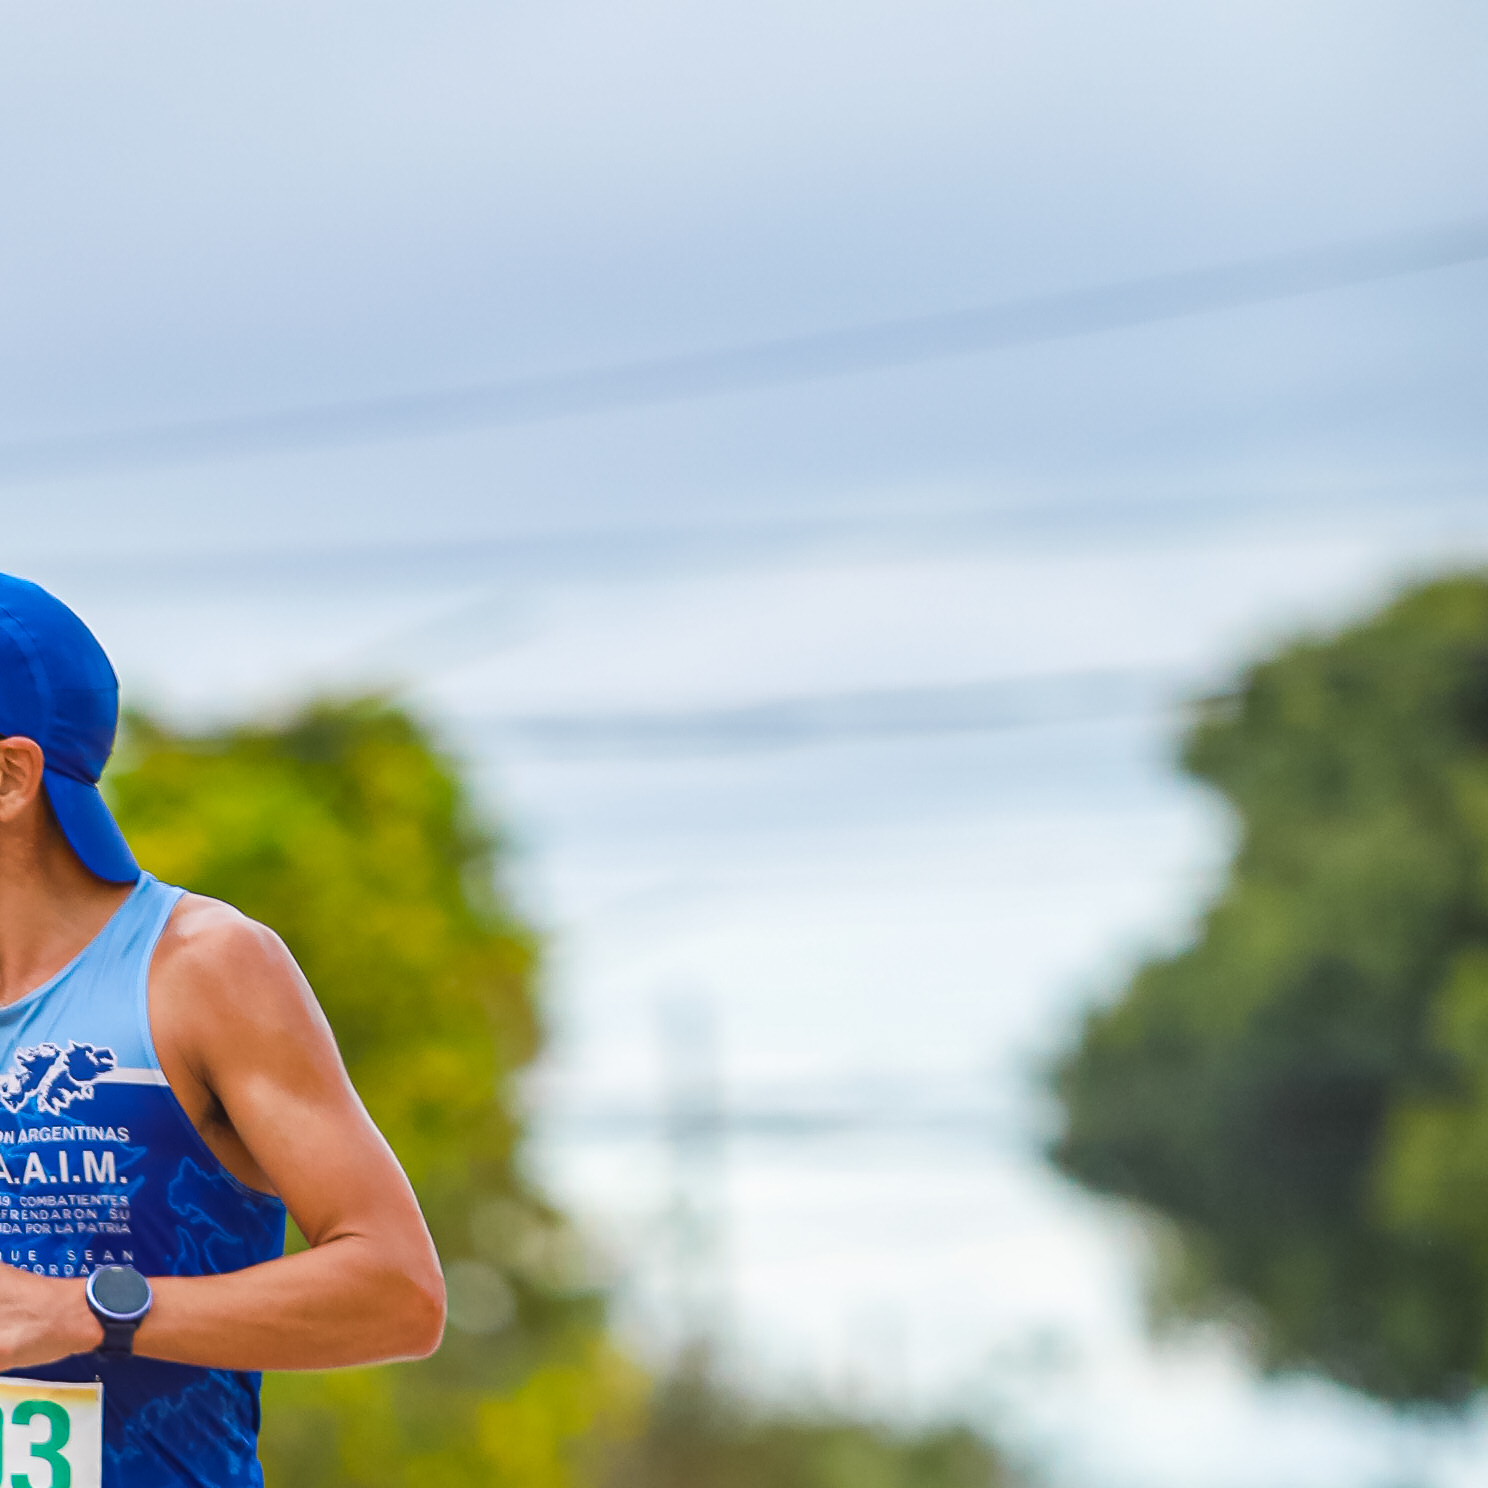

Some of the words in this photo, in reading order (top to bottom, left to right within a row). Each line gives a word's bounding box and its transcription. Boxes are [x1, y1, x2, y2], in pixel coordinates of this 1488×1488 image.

[17, 1126, 130, 1143] ARGENTINAS
[19, 1195, 129, 1207] COMBATIENTES
[109, 1208, 130, 1220] SU
[25, 1222, 52, 1234] POR
[55, 1222, 74, 1234] LA
[77, 1222, 132, 1234] PATRIA
[67, 1250, 134, 1261] SEAN
